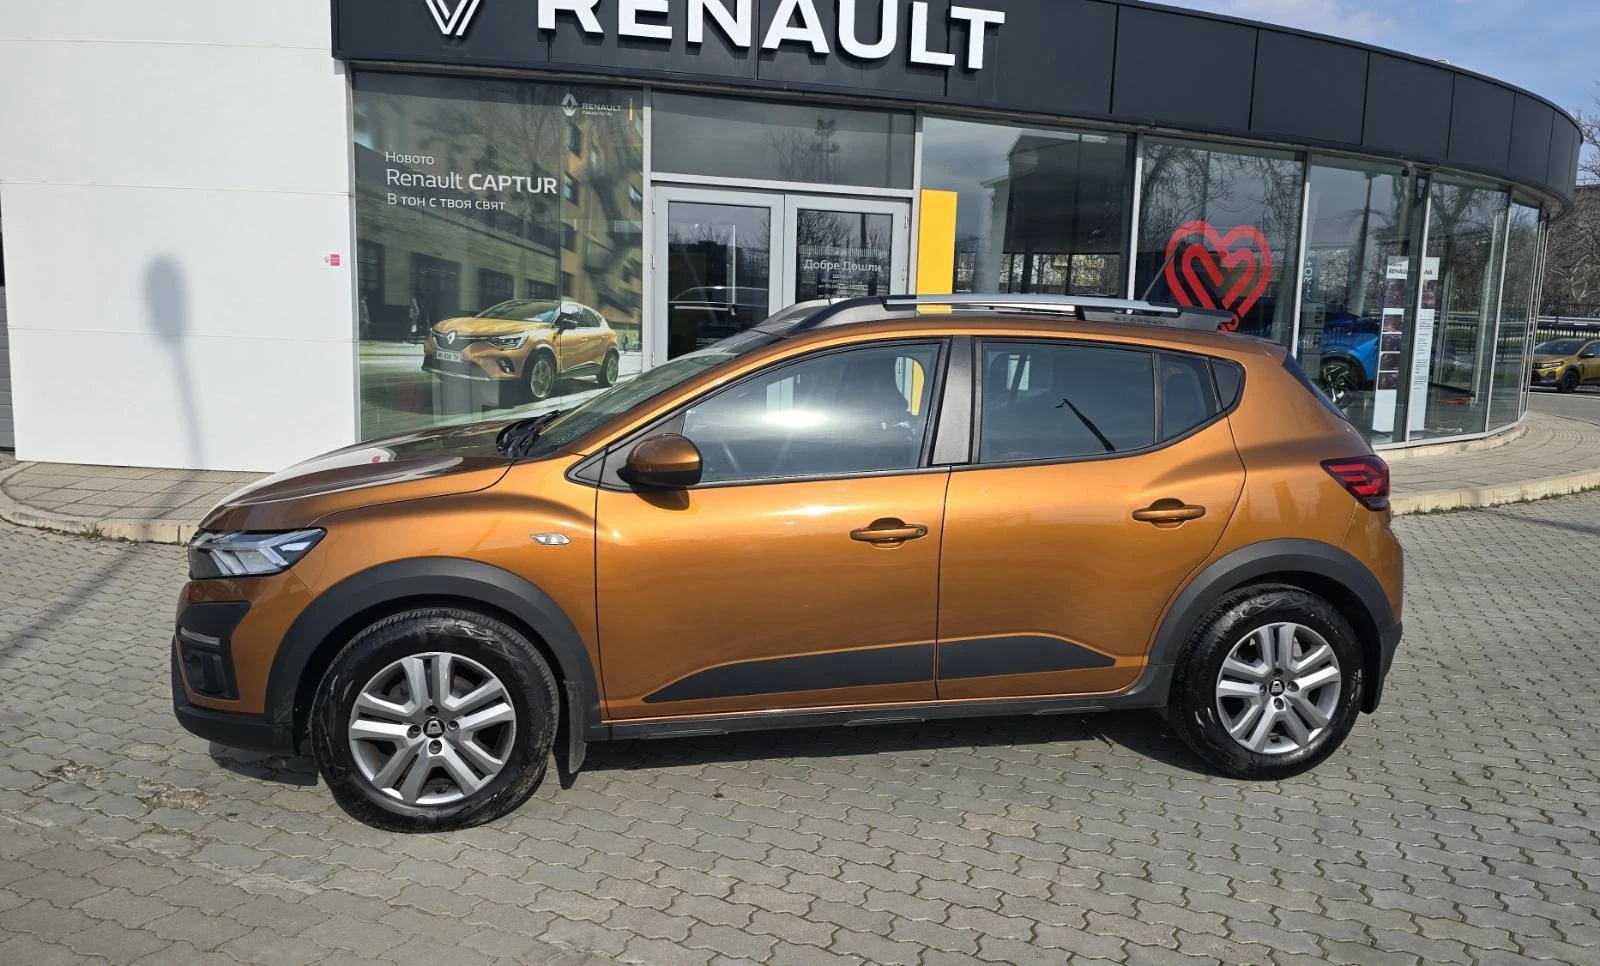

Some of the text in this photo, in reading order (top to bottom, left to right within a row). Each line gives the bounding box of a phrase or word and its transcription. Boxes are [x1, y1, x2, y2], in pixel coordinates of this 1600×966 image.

[582, 103, 622, 112] RENAULT
[385, 151, 435, 165] Новото
[386, 168, 557, 194] Renault CAPTUR
[387, 193, 505, 210] В тон с твоя свят
[803, 260, 882, 272] Добре Дошли
